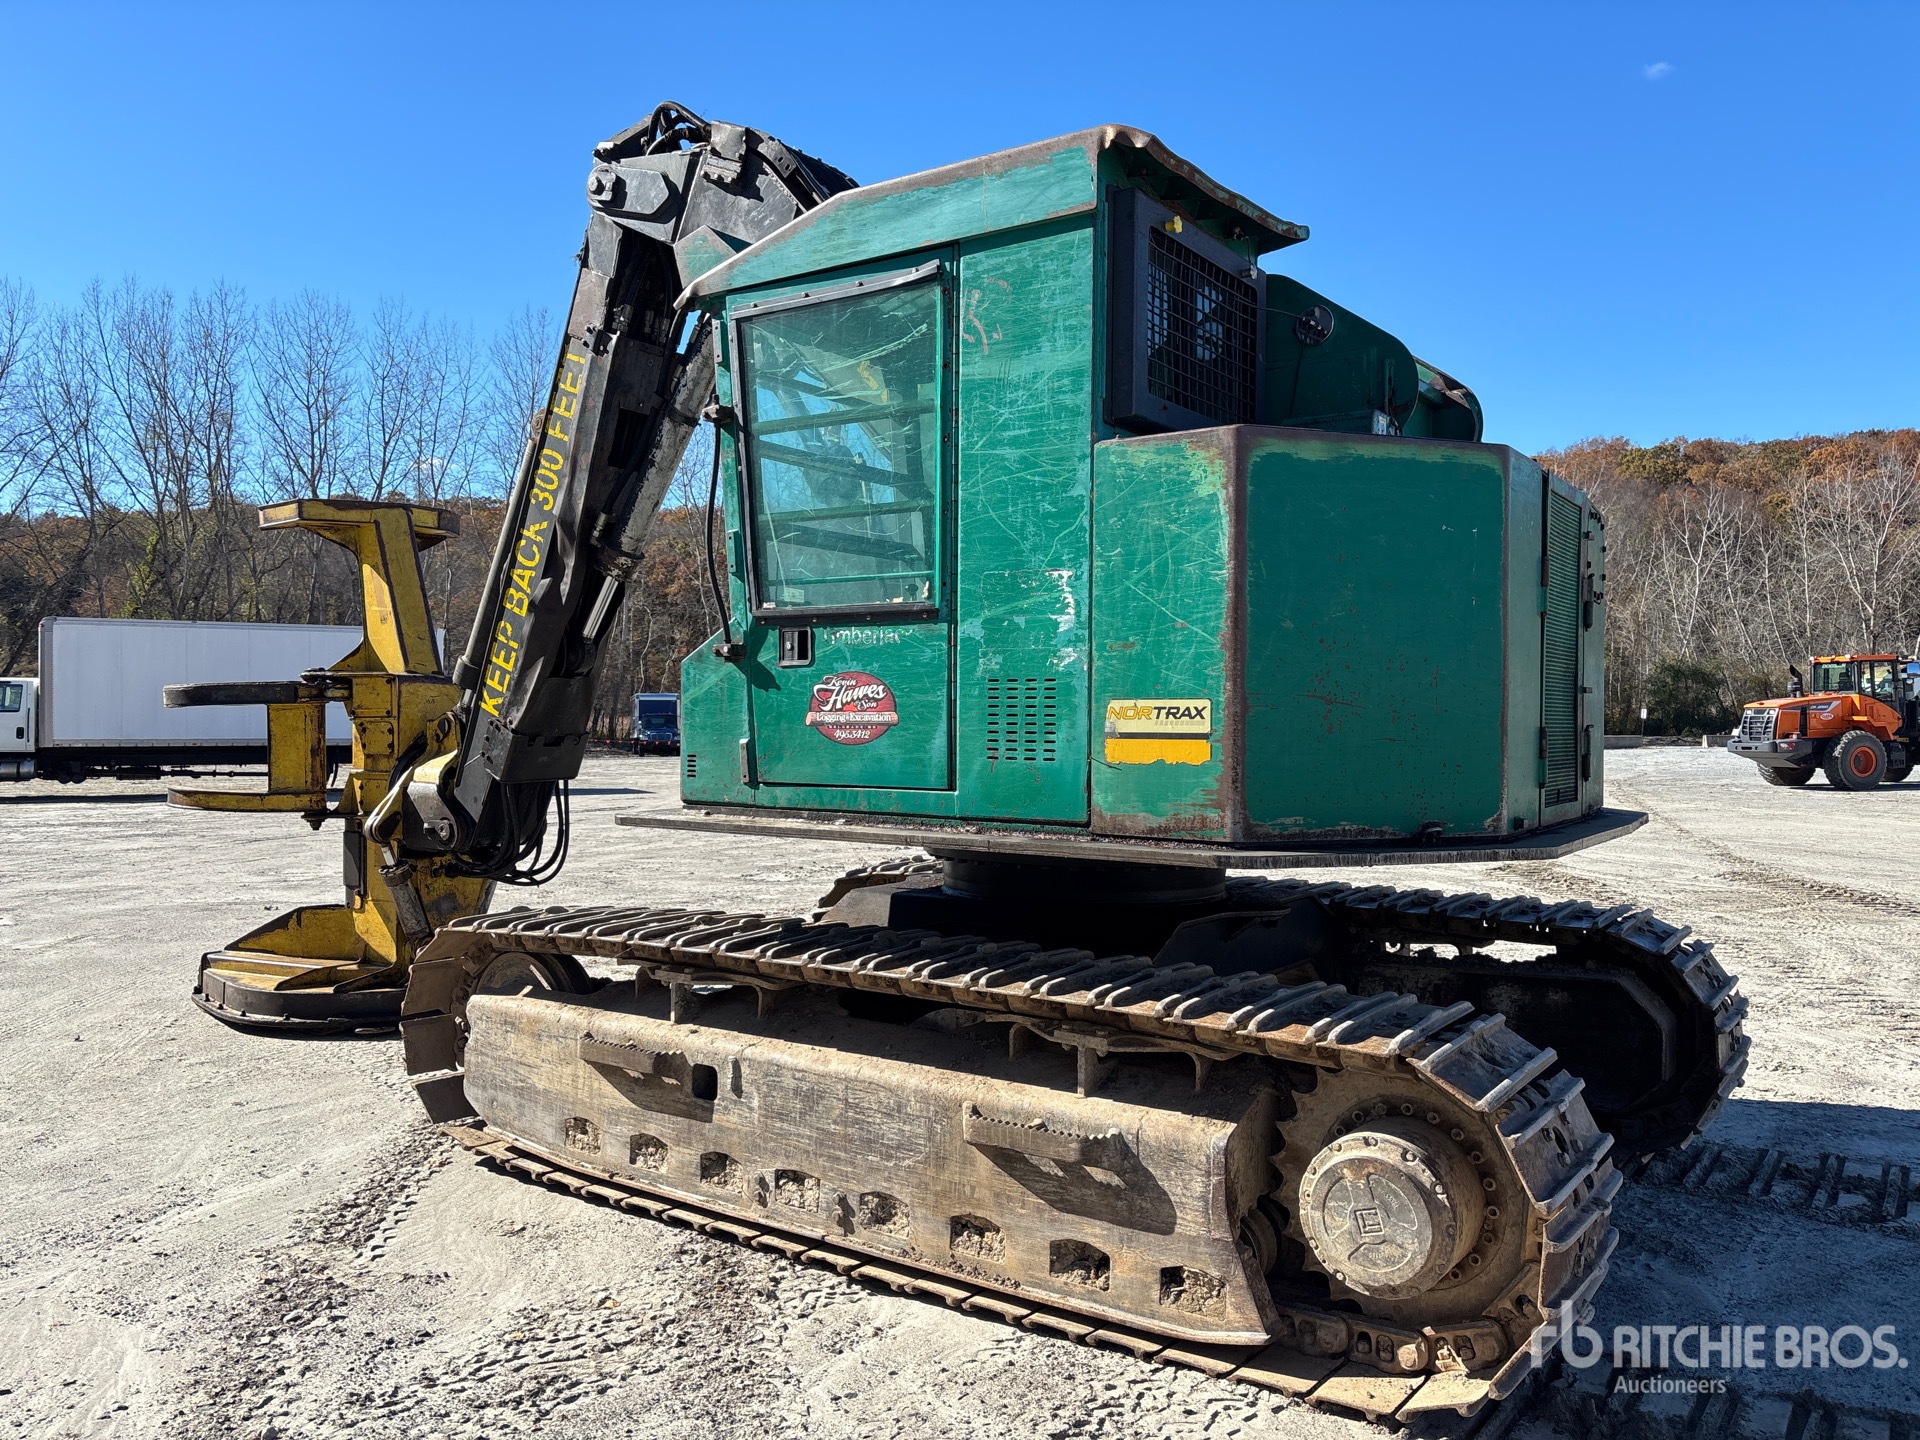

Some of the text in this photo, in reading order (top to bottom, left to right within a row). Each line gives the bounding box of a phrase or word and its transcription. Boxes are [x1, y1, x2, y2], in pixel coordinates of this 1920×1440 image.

[479, 619, 521, 717] KEEP
[502, 520, 549, 617] BACK
[530, 448, 563, 511] 300
[823, 676, 857, 686] Kevin
[814, 684, 887, 711] Hawes
[858, 700, 877, 711] Son
[816, 713, 845, 722] Logging
[849, 713, 891, 721] Excavation
[1108, 706, 1207, 720] NORTRAX
